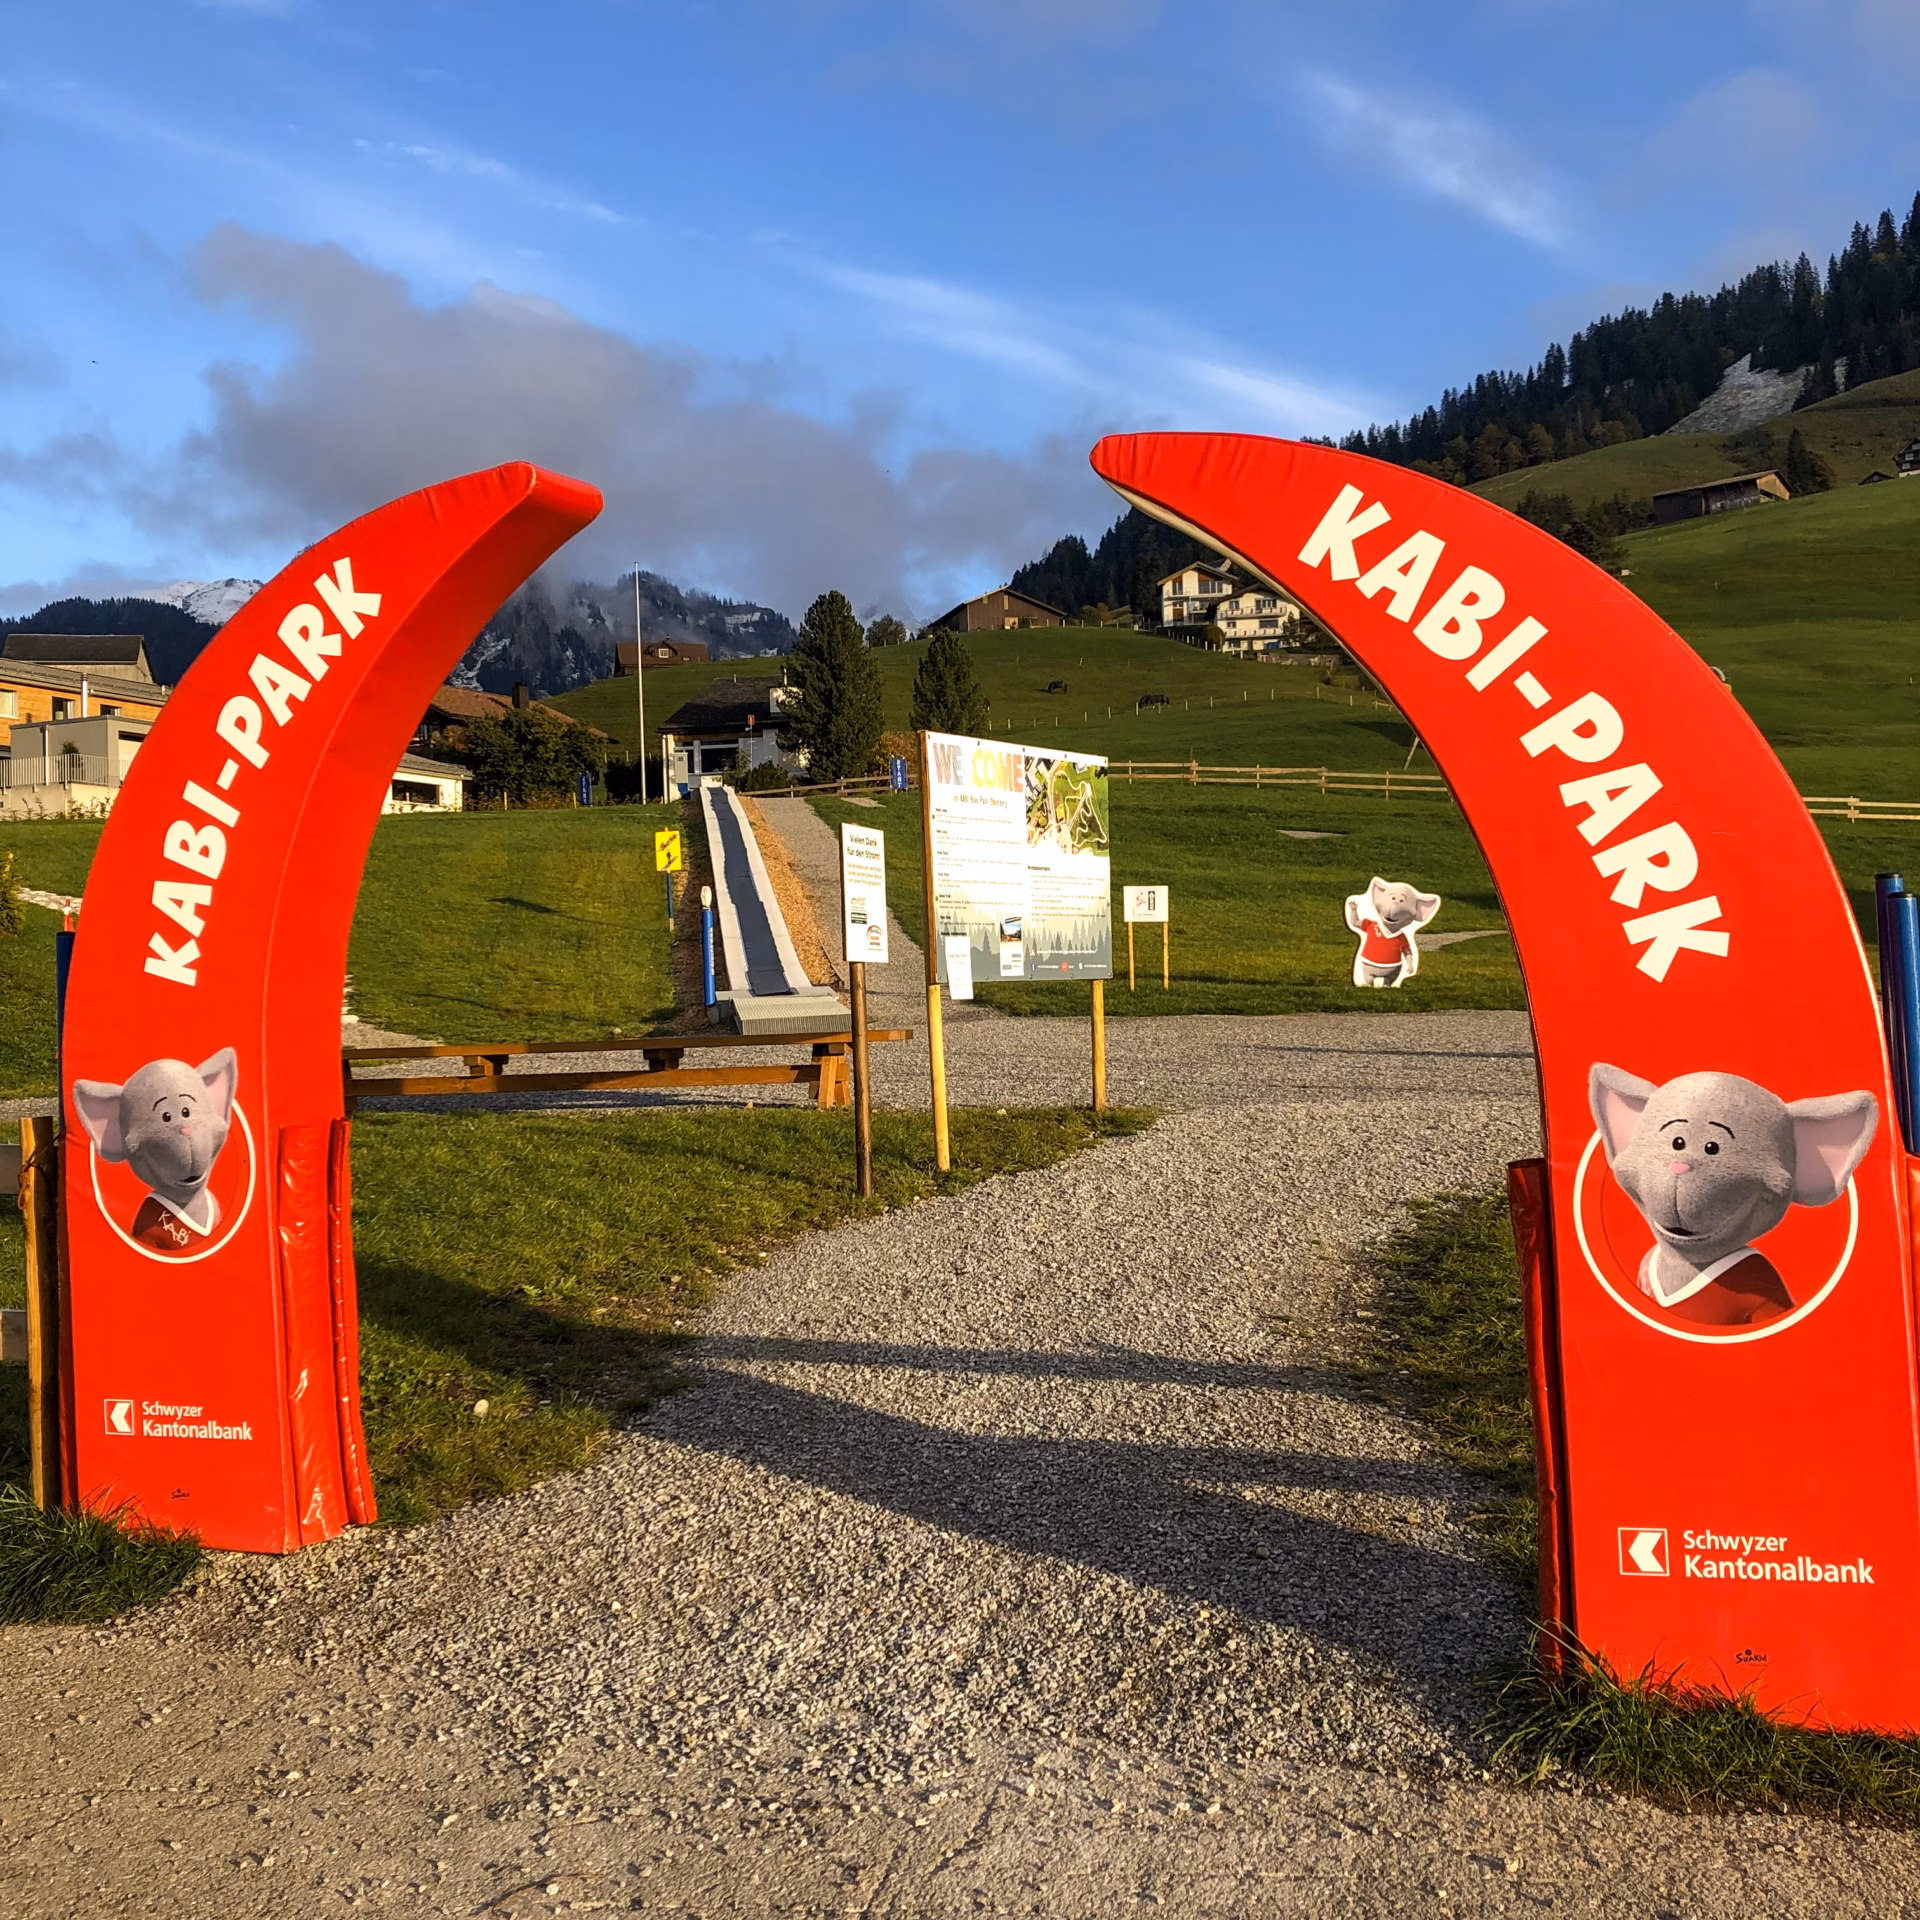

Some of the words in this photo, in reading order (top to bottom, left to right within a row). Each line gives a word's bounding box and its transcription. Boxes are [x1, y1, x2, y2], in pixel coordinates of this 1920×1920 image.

[1297, 482, 1730, 984] KABI-PARK
[144, 556, 382, 987] KABI-PARK
[933, 743, 1023, 793] WECOME
[847, 845, 855, 856] für
[856, 849, 865, 858] den
[849, 834, 865, 845] Vielen
[866, 837, 878, 847] Dank
[141, 1401, 204, 1421] Schwyzer
[142, 1419, 253, 1441] Kantonalbank
[1683, 1529, 1788, 1556] Schwyzer
[1684, 1554, 1876, 1585] Kantonalbank
